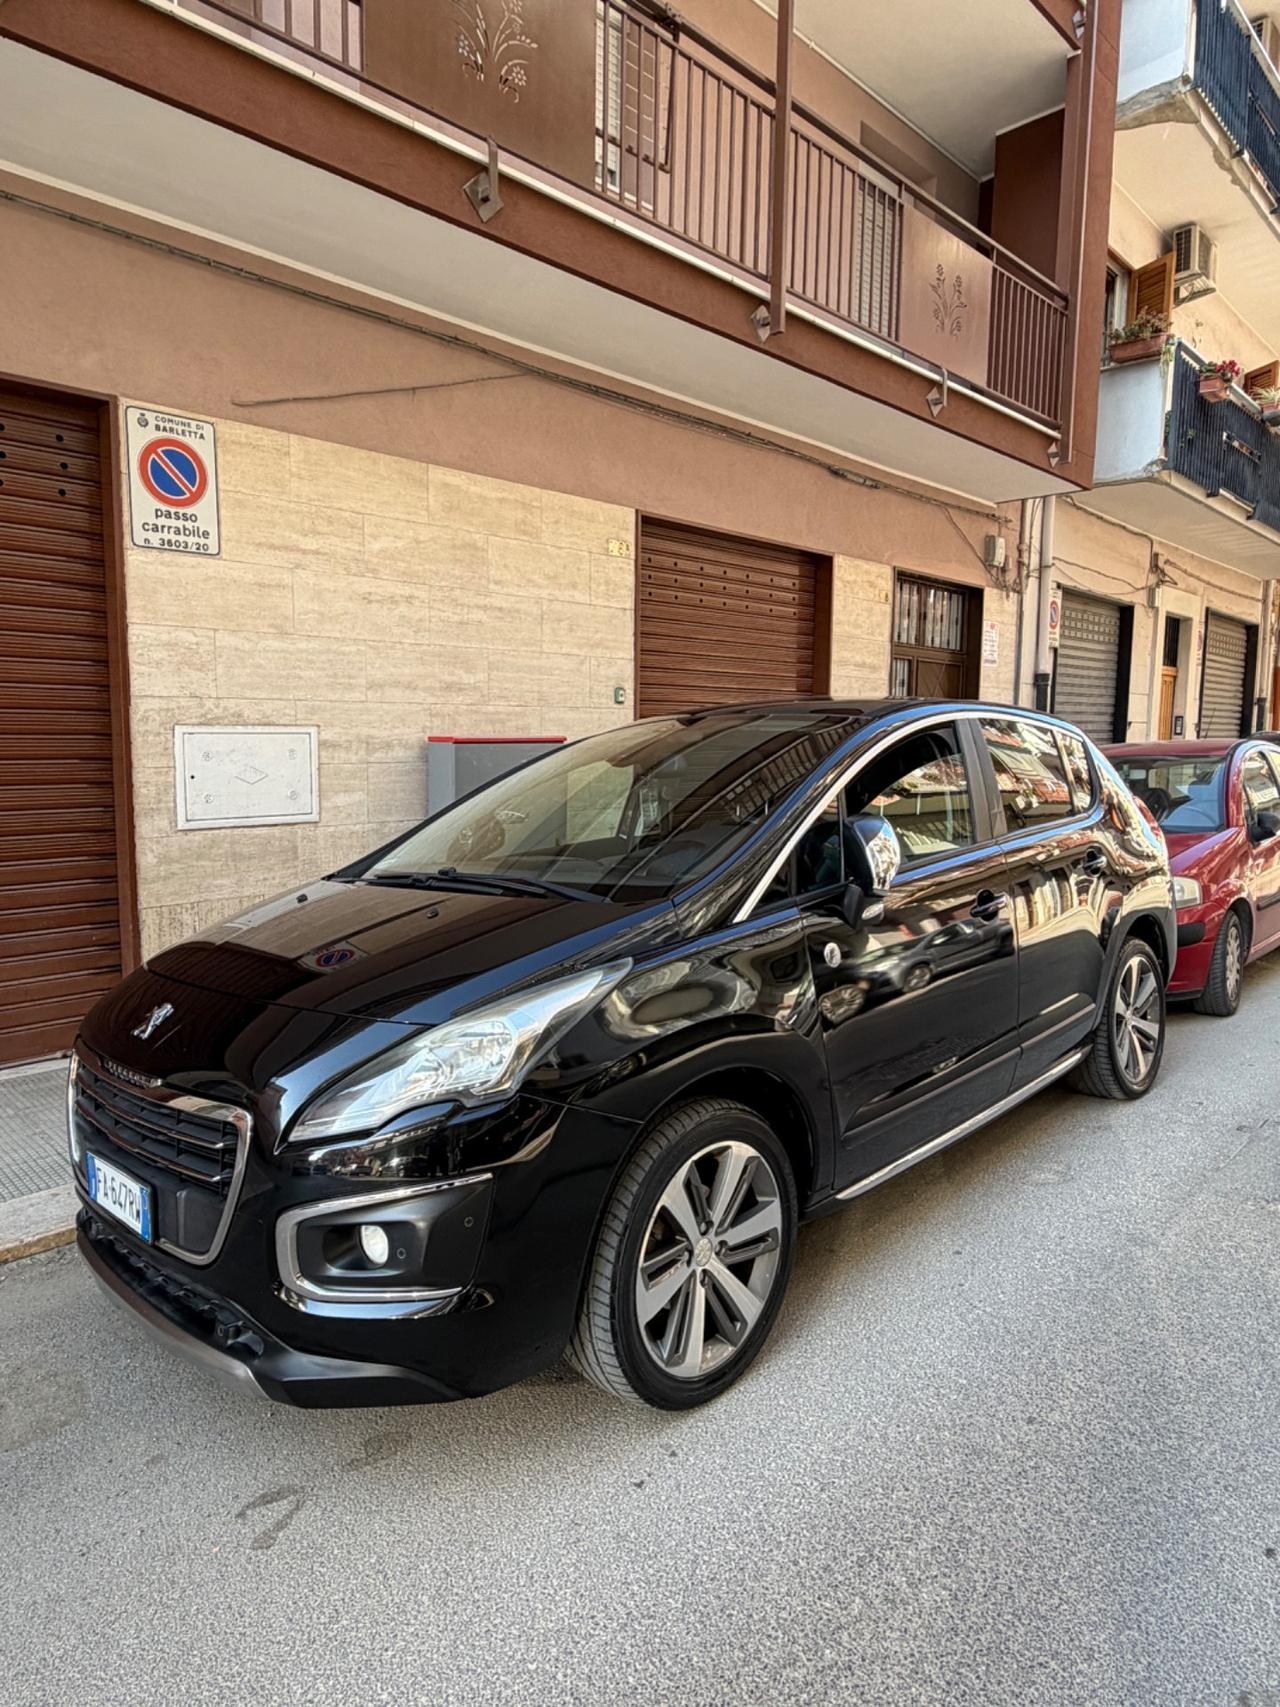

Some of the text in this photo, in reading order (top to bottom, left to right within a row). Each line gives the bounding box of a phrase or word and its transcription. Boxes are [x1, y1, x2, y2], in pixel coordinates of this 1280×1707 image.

[154, 415, 205, 431] COMUNE DI
[154, 423, 205, 440] BARLETTA
[154, 507, 198, 523] passo
[142, 521, 210, 539] carrabile
[143, 537, 154, 546] n.
